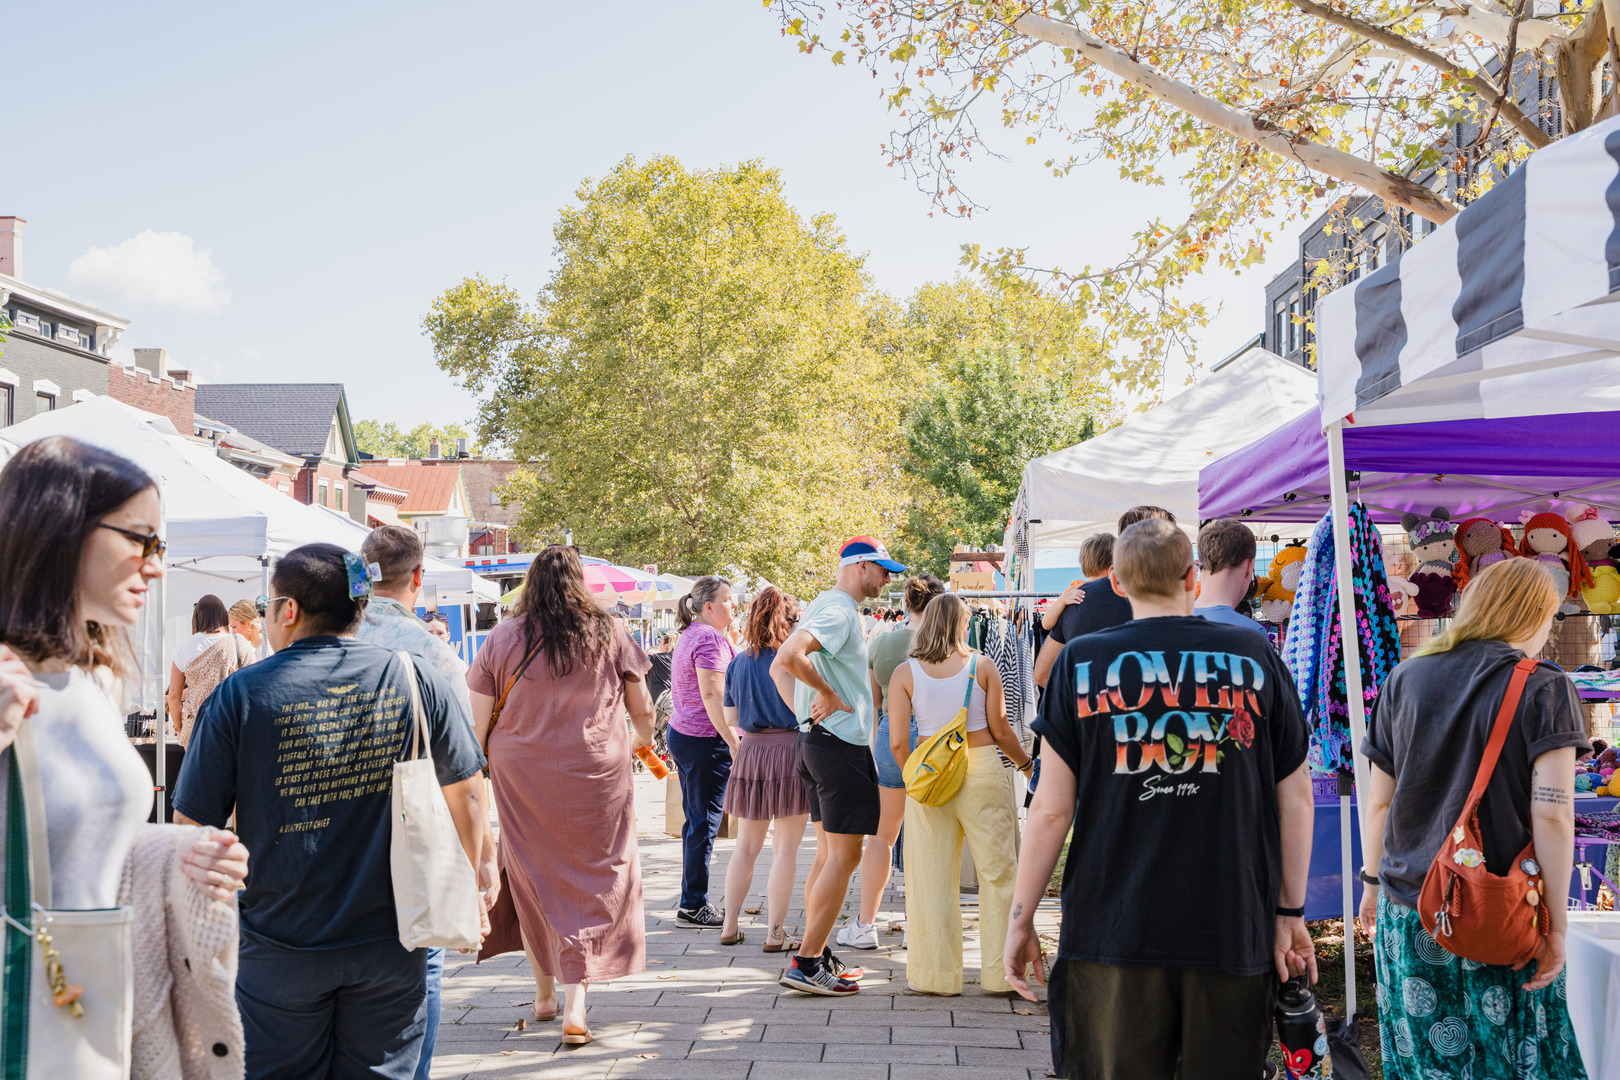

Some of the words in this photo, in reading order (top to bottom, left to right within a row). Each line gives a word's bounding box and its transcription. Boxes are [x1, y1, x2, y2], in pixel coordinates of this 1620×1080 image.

[1074, 650, 1266, 719] LOVER
[281, 704, 293, 713] THE
[316, 711, 328, 720] AND
[281, 728, 288, 737] IT
[289, 726, 305, 736] DOES
[360, 738, 372, 748] THE
[1110, 710, 1234, 775] BOY
[282, 764, 294, 774] CAN
[358, 749, 373, 760] SAND
[374, 747, 386, 757] AND
[275, 776, 283, 786] OF
[302, 771, 311, 781] OF
[353, 762, 362, 771] AS
[362, 761, 367, 770] A
[302, 783, 317, 793] GIVE
[318, 781, 330, 791] YOU
[1138, 775, 1174, 801] Since
[294, 797, 306, 807] CAN
[307, 794, 322, 806] TAKE
[322, 791, 338, 803] WITH
[353, 786, 365, 797] BUT
[278, 825, 284, 834] A
